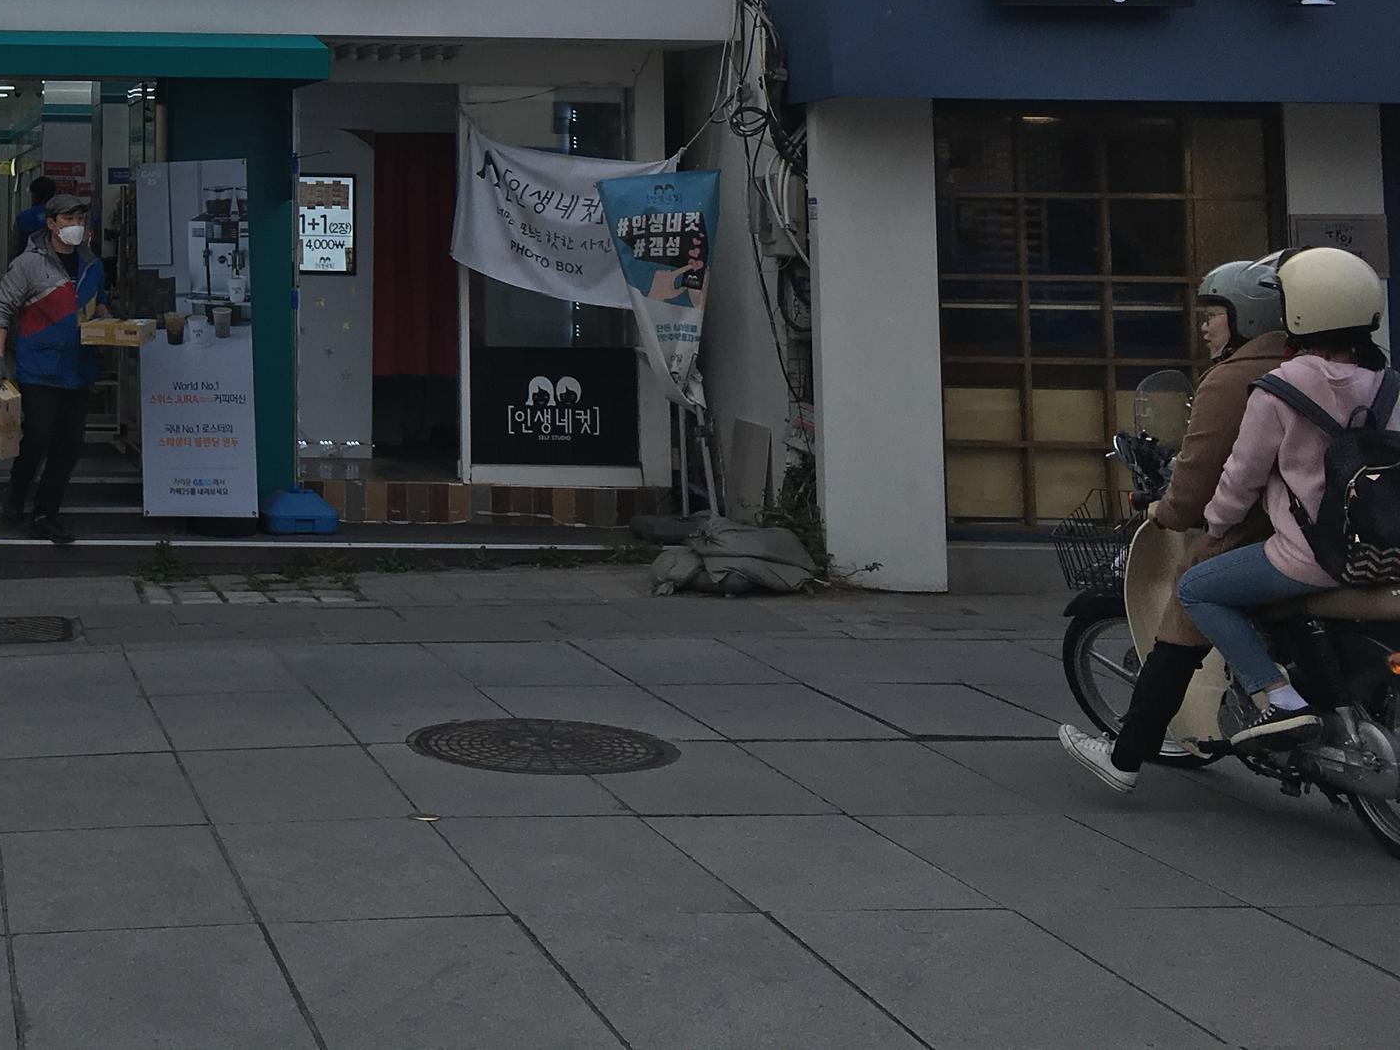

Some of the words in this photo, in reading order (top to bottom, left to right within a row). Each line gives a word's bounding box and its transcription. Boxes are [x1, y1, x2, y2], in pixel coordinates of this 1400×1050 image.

[617, 212, 700, 237] #인생네컷
[510, 240, 550, 268] PHOTO
[556, 261, 584, 275] BOX
[633, 236, 681, 258] #갬성
[172, 382, 198, 390] World
[201, 382, 219, 390] No.1
[214, 394, 247, 405] 커피머신
[165, 424, 181, 434] 국내
[182, 424, 200, 433] No.1
[202, 423, 233, 434] 로스터의
[508, 405, 600, 435] [인생네컷]
